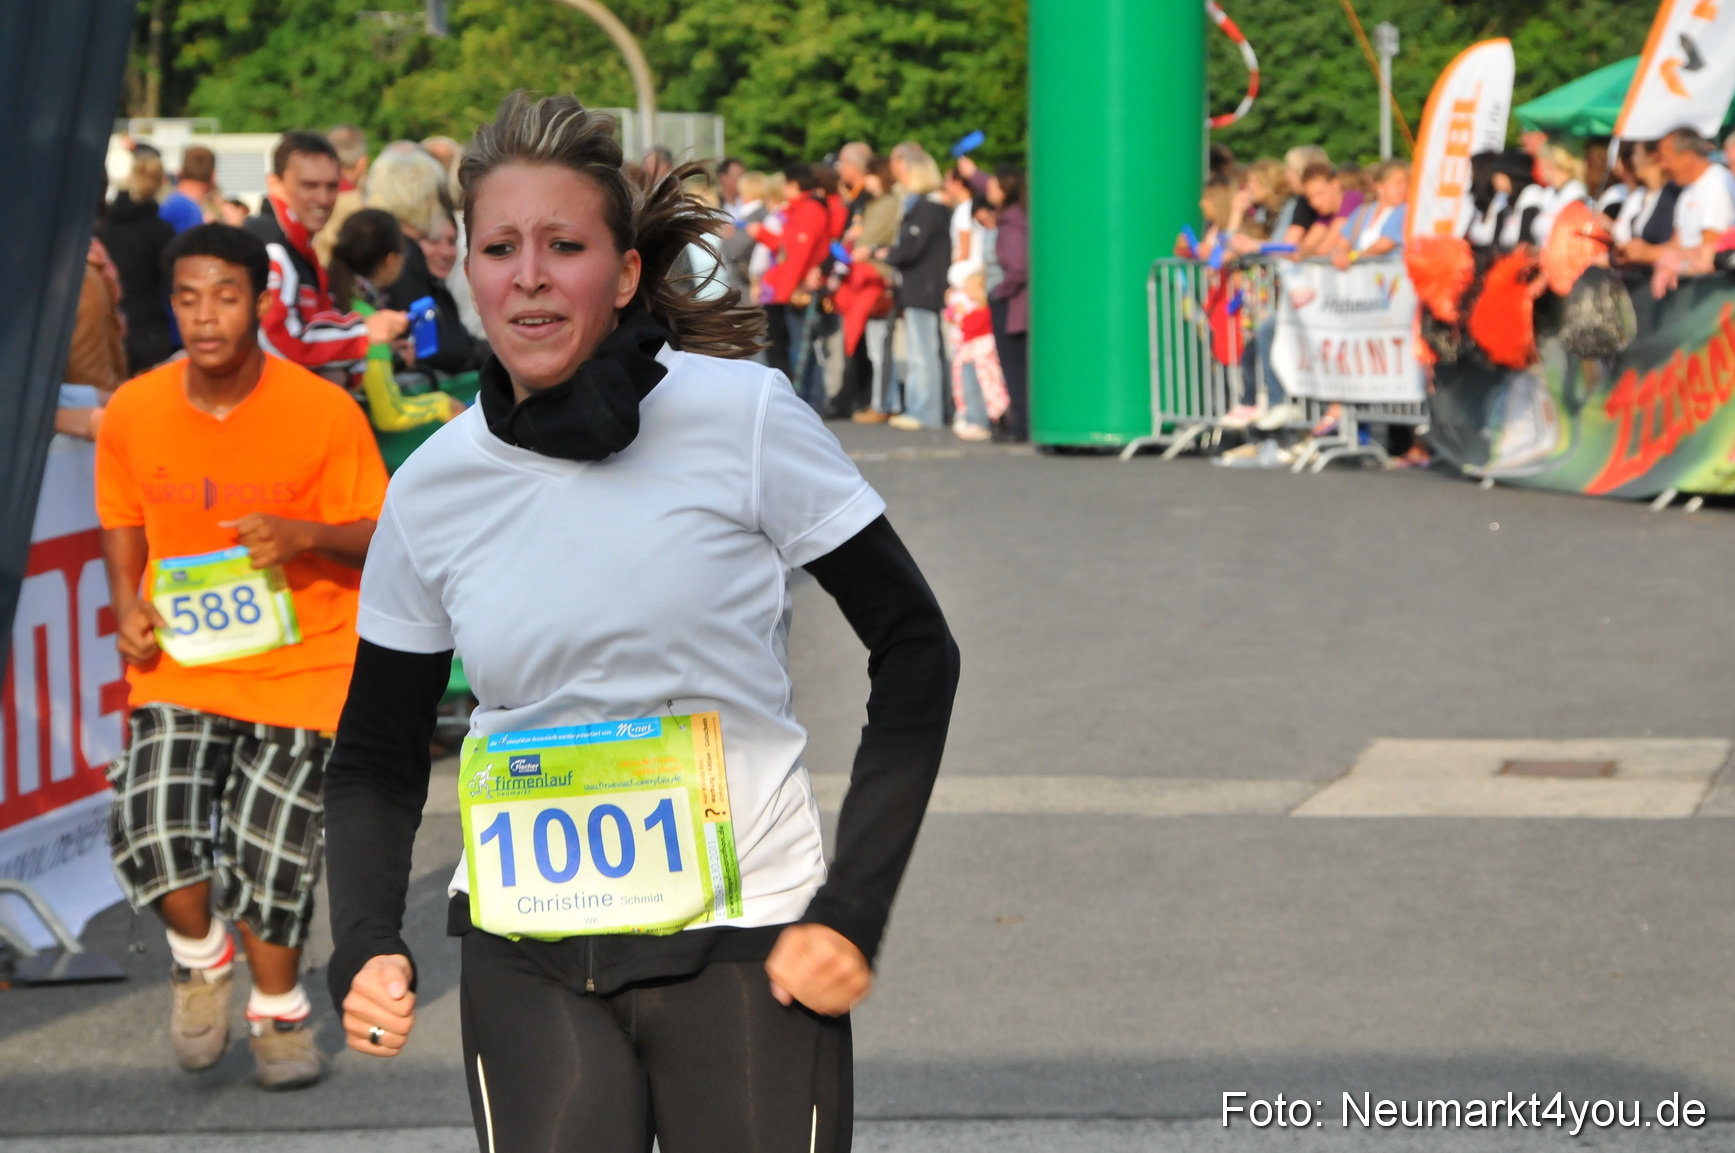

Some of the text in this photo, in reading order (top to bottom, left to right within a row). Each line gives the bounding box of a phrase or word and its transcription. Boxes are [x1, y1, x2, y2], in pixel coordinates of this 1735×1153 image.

[172, 585, 262, 636] 588
[495, 771, 573, 791] firmenlauf
[480, 798, 683, 888] 1001
[517, 891, 664, 915] Christine Schmidt
